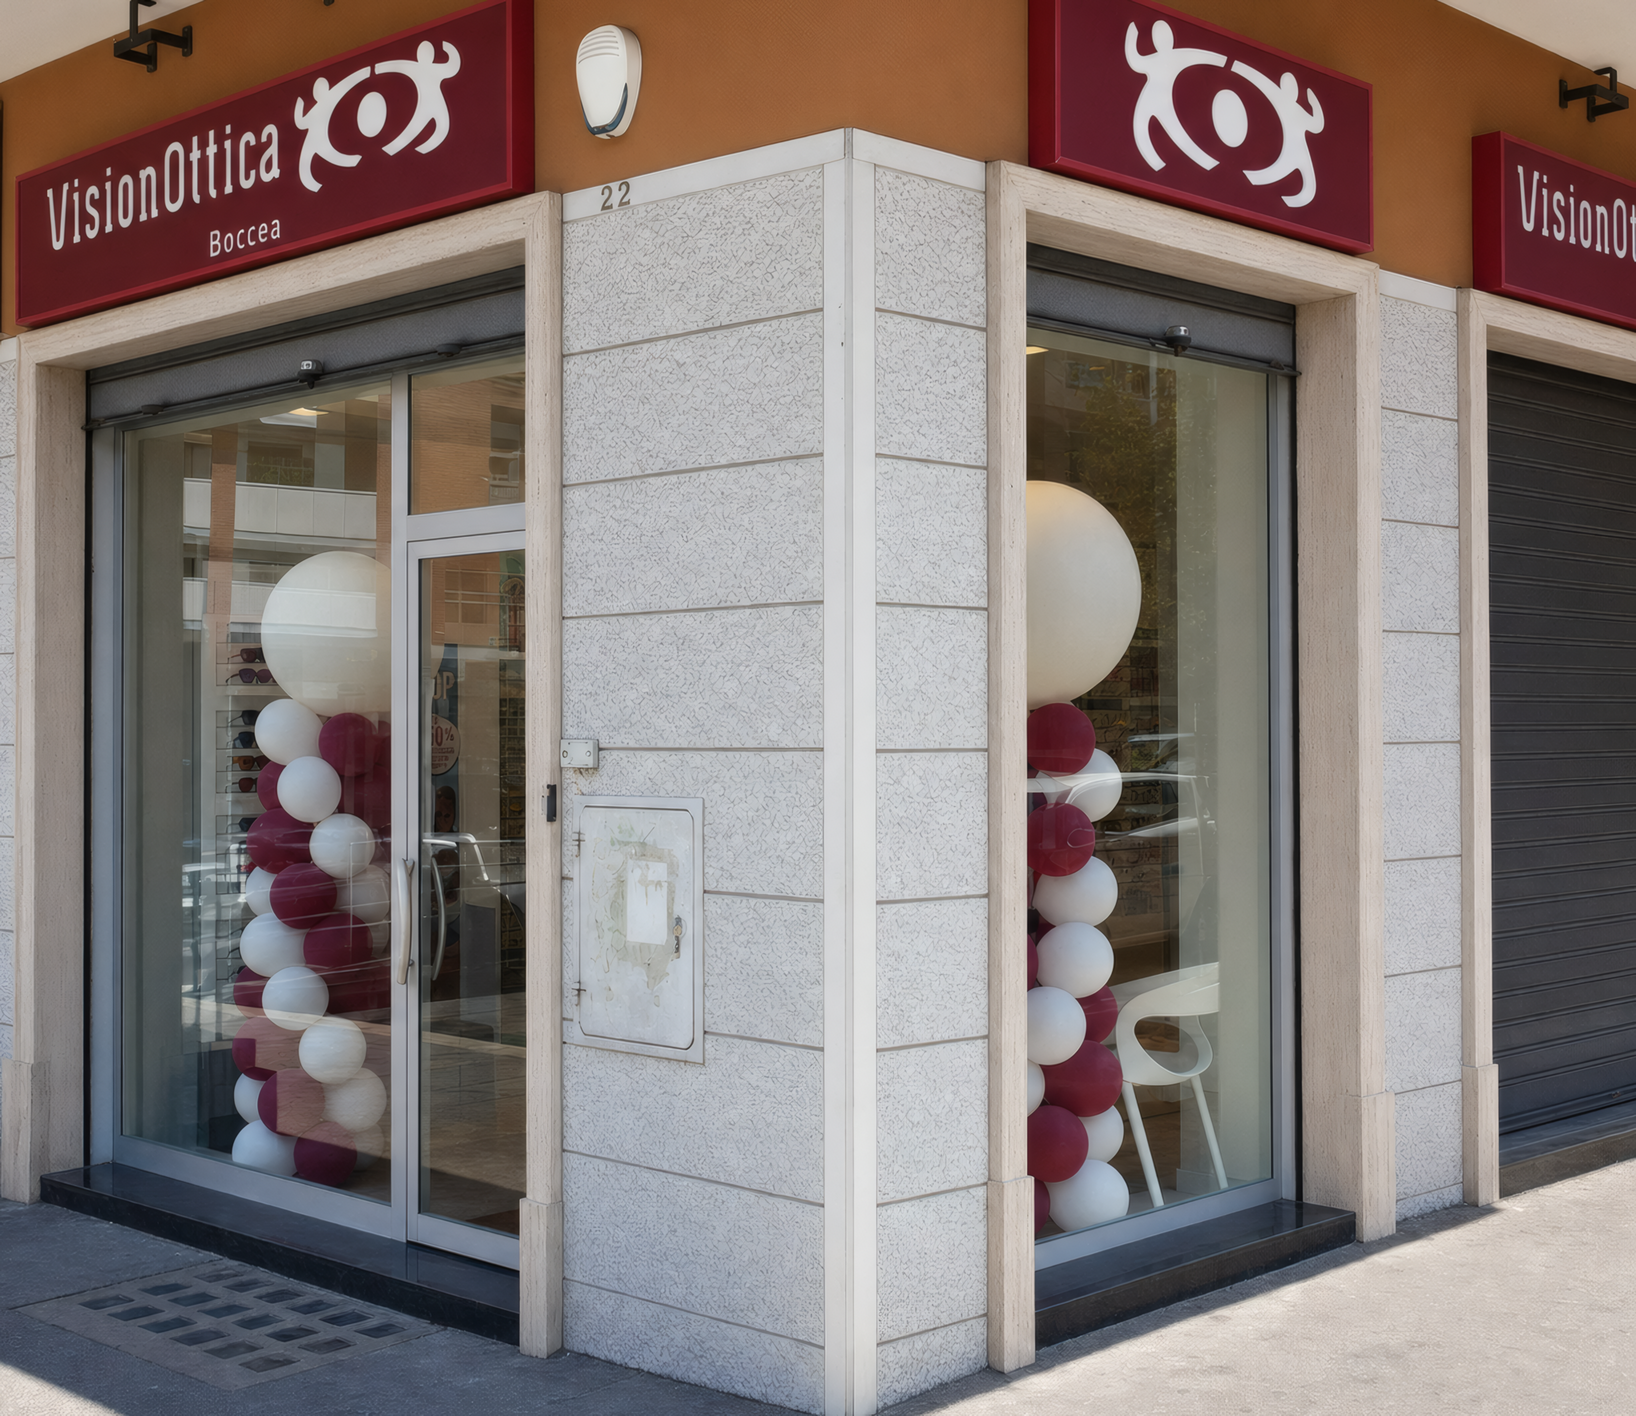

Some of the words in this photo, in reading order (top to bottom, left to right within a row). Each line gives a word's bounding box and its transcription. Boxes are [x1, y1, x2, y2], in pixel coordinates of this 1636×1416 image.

[47, 123, 280, 251] VisionOttica
[601, 181, 631, 211] 22
[209, 219, 281, 258] Boccea
